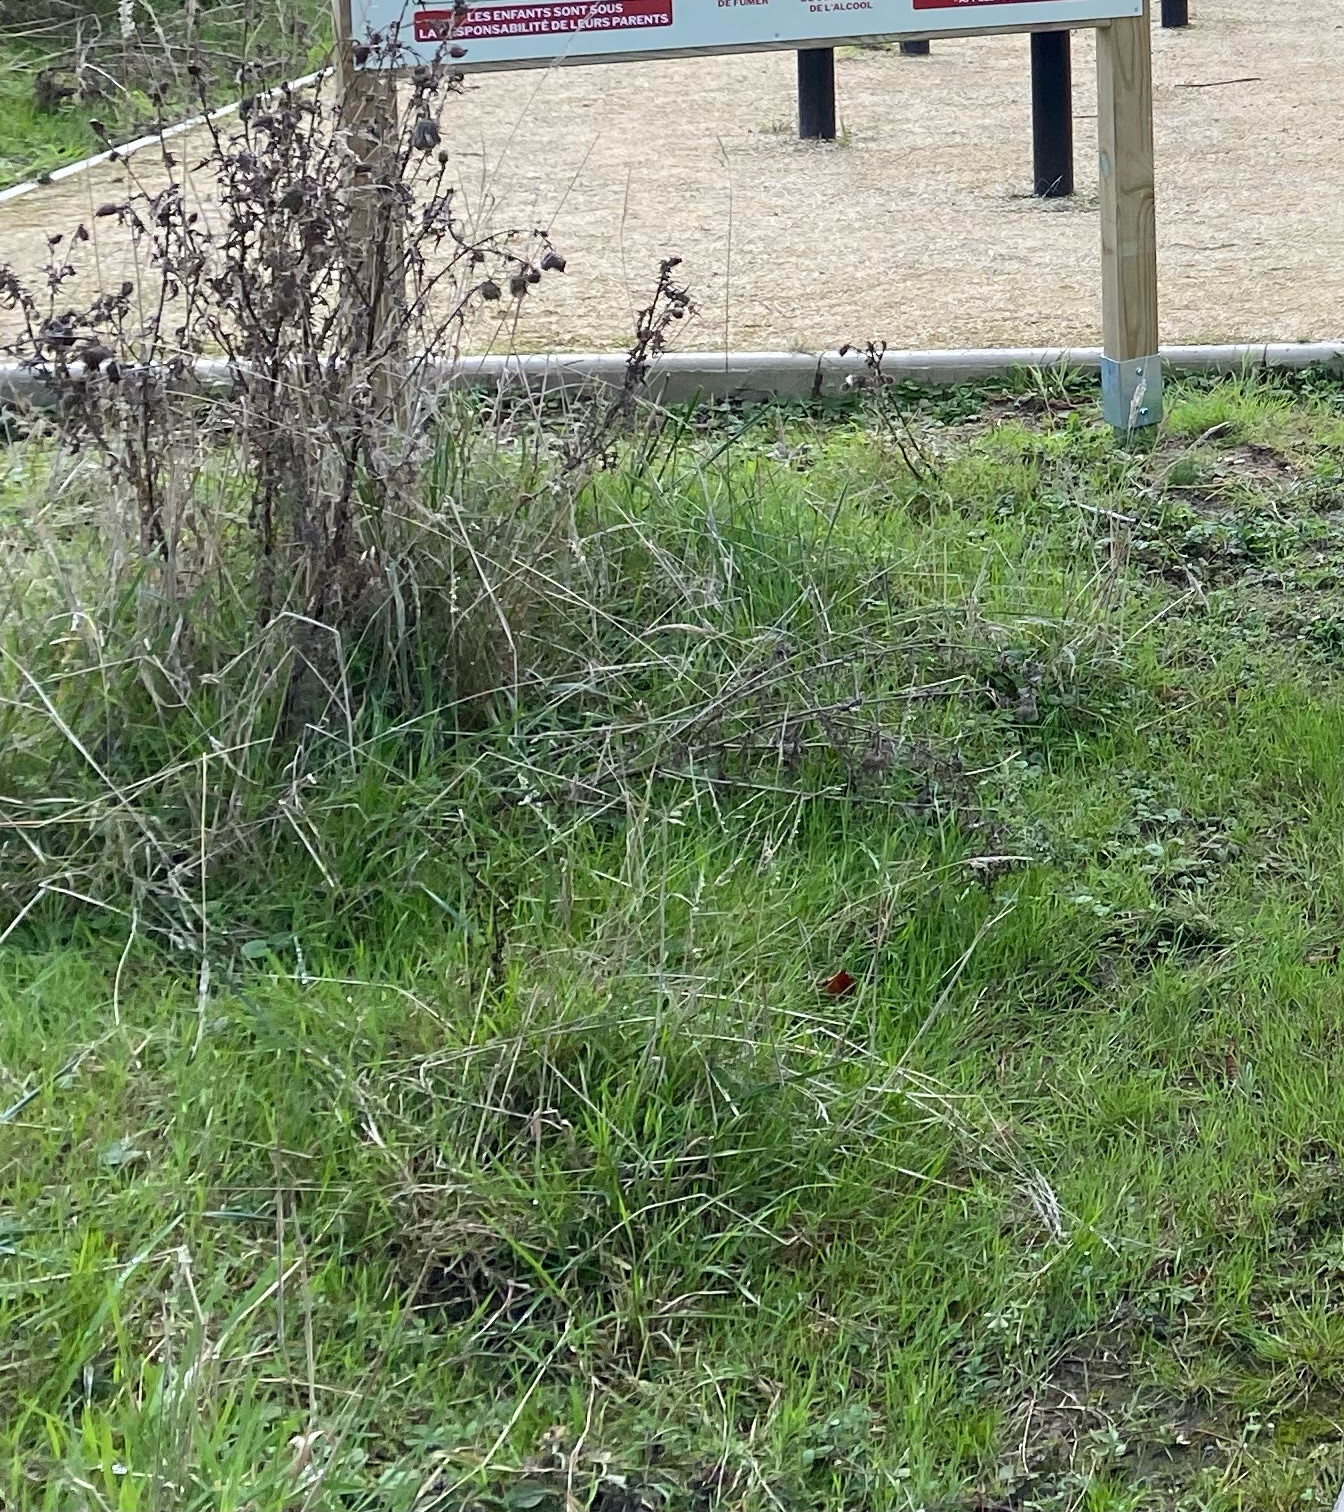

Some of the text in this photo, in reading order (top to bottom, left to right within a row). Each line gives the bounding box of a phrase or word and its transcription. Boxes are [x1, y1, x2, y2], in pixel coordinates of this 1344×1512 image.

[467, 3, 623, 22] LES ENFANTS SONT SOUS
[825, 2, 872, 11] L'ALCOOL
[419, 13, 668, 39] LA SPONSABILITÉ DE LEURS PARENTS
